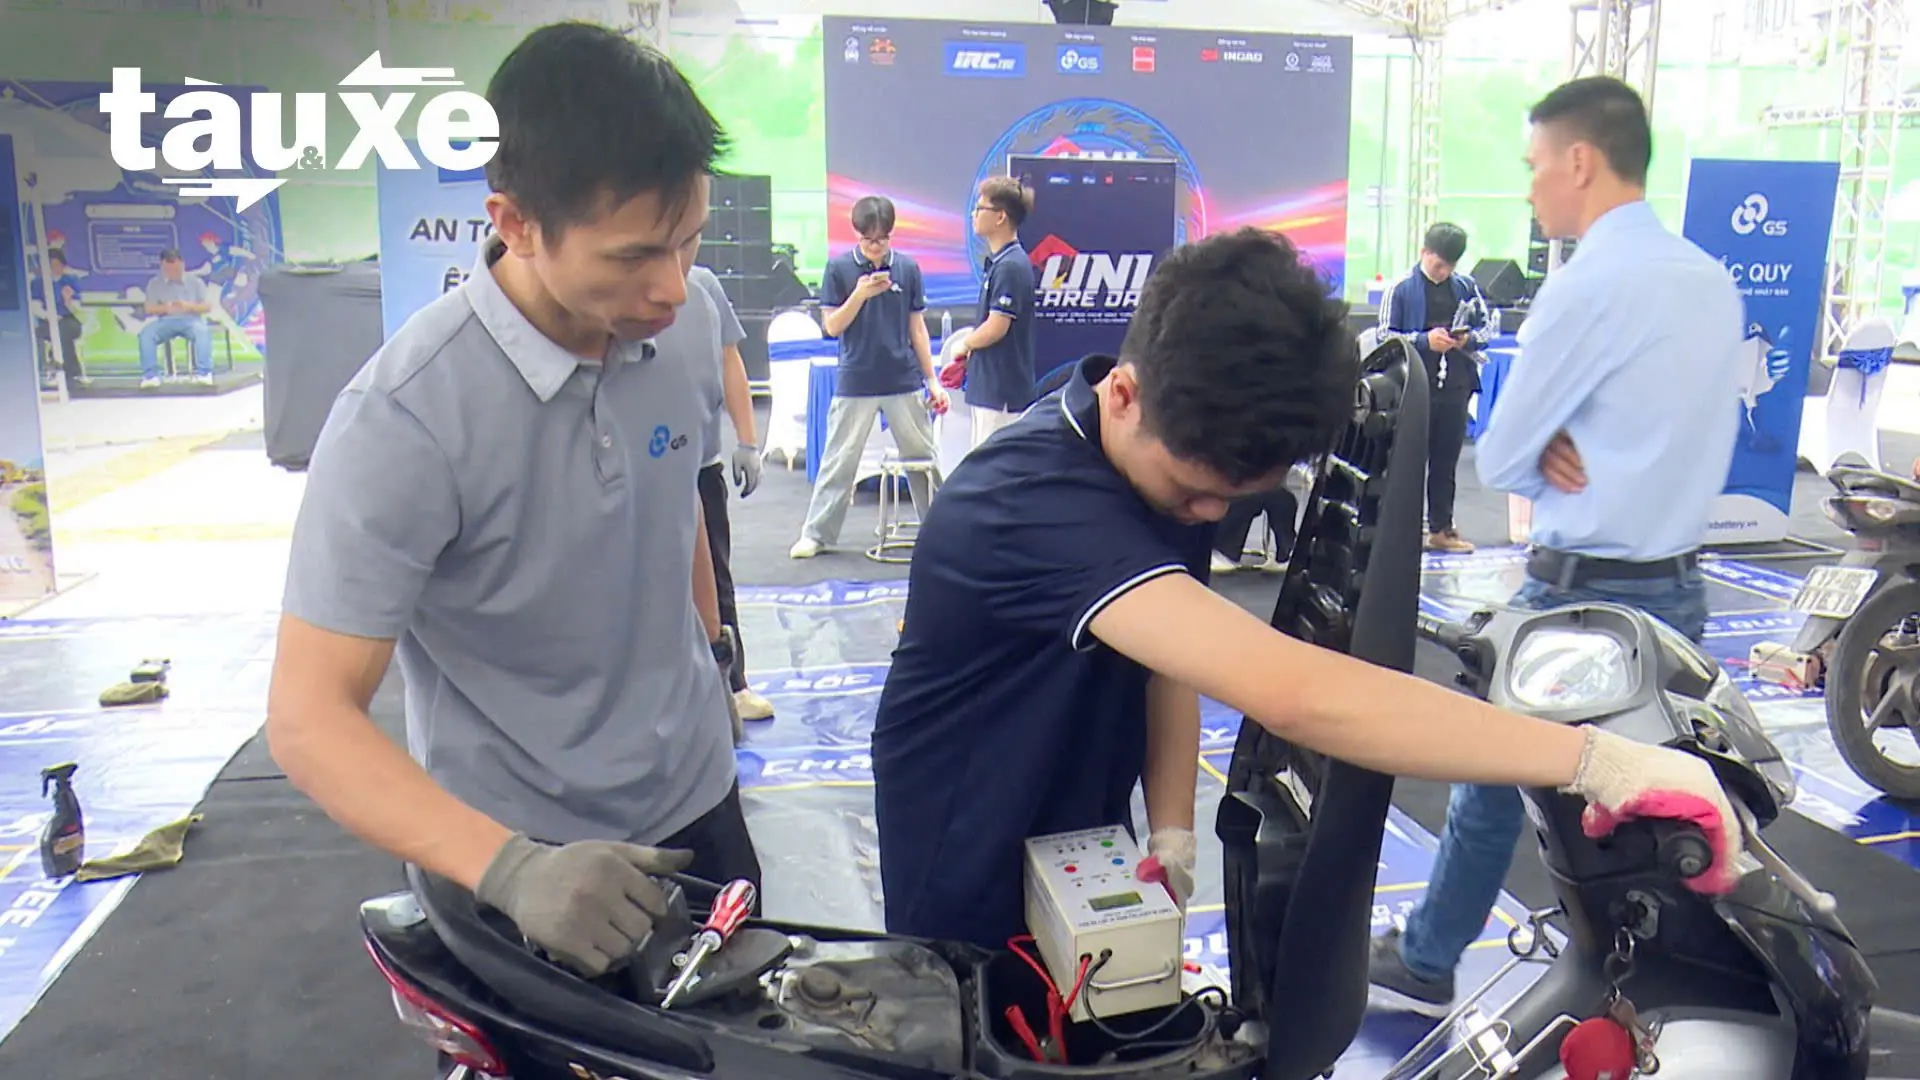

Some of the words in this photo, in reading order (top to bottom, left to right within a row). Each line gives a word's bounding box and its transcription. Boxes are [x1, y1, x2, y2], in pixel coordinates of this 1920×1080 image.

[409, 218, 458, 242] AN
[1762, 220, 1788, 236] GS
[1040, 252, 1154, 290] UNI
[1748, 263, 1793, 283] QUY
[1104, 289, 1142, 307] DA
[670, 433, 688, 450] GS
